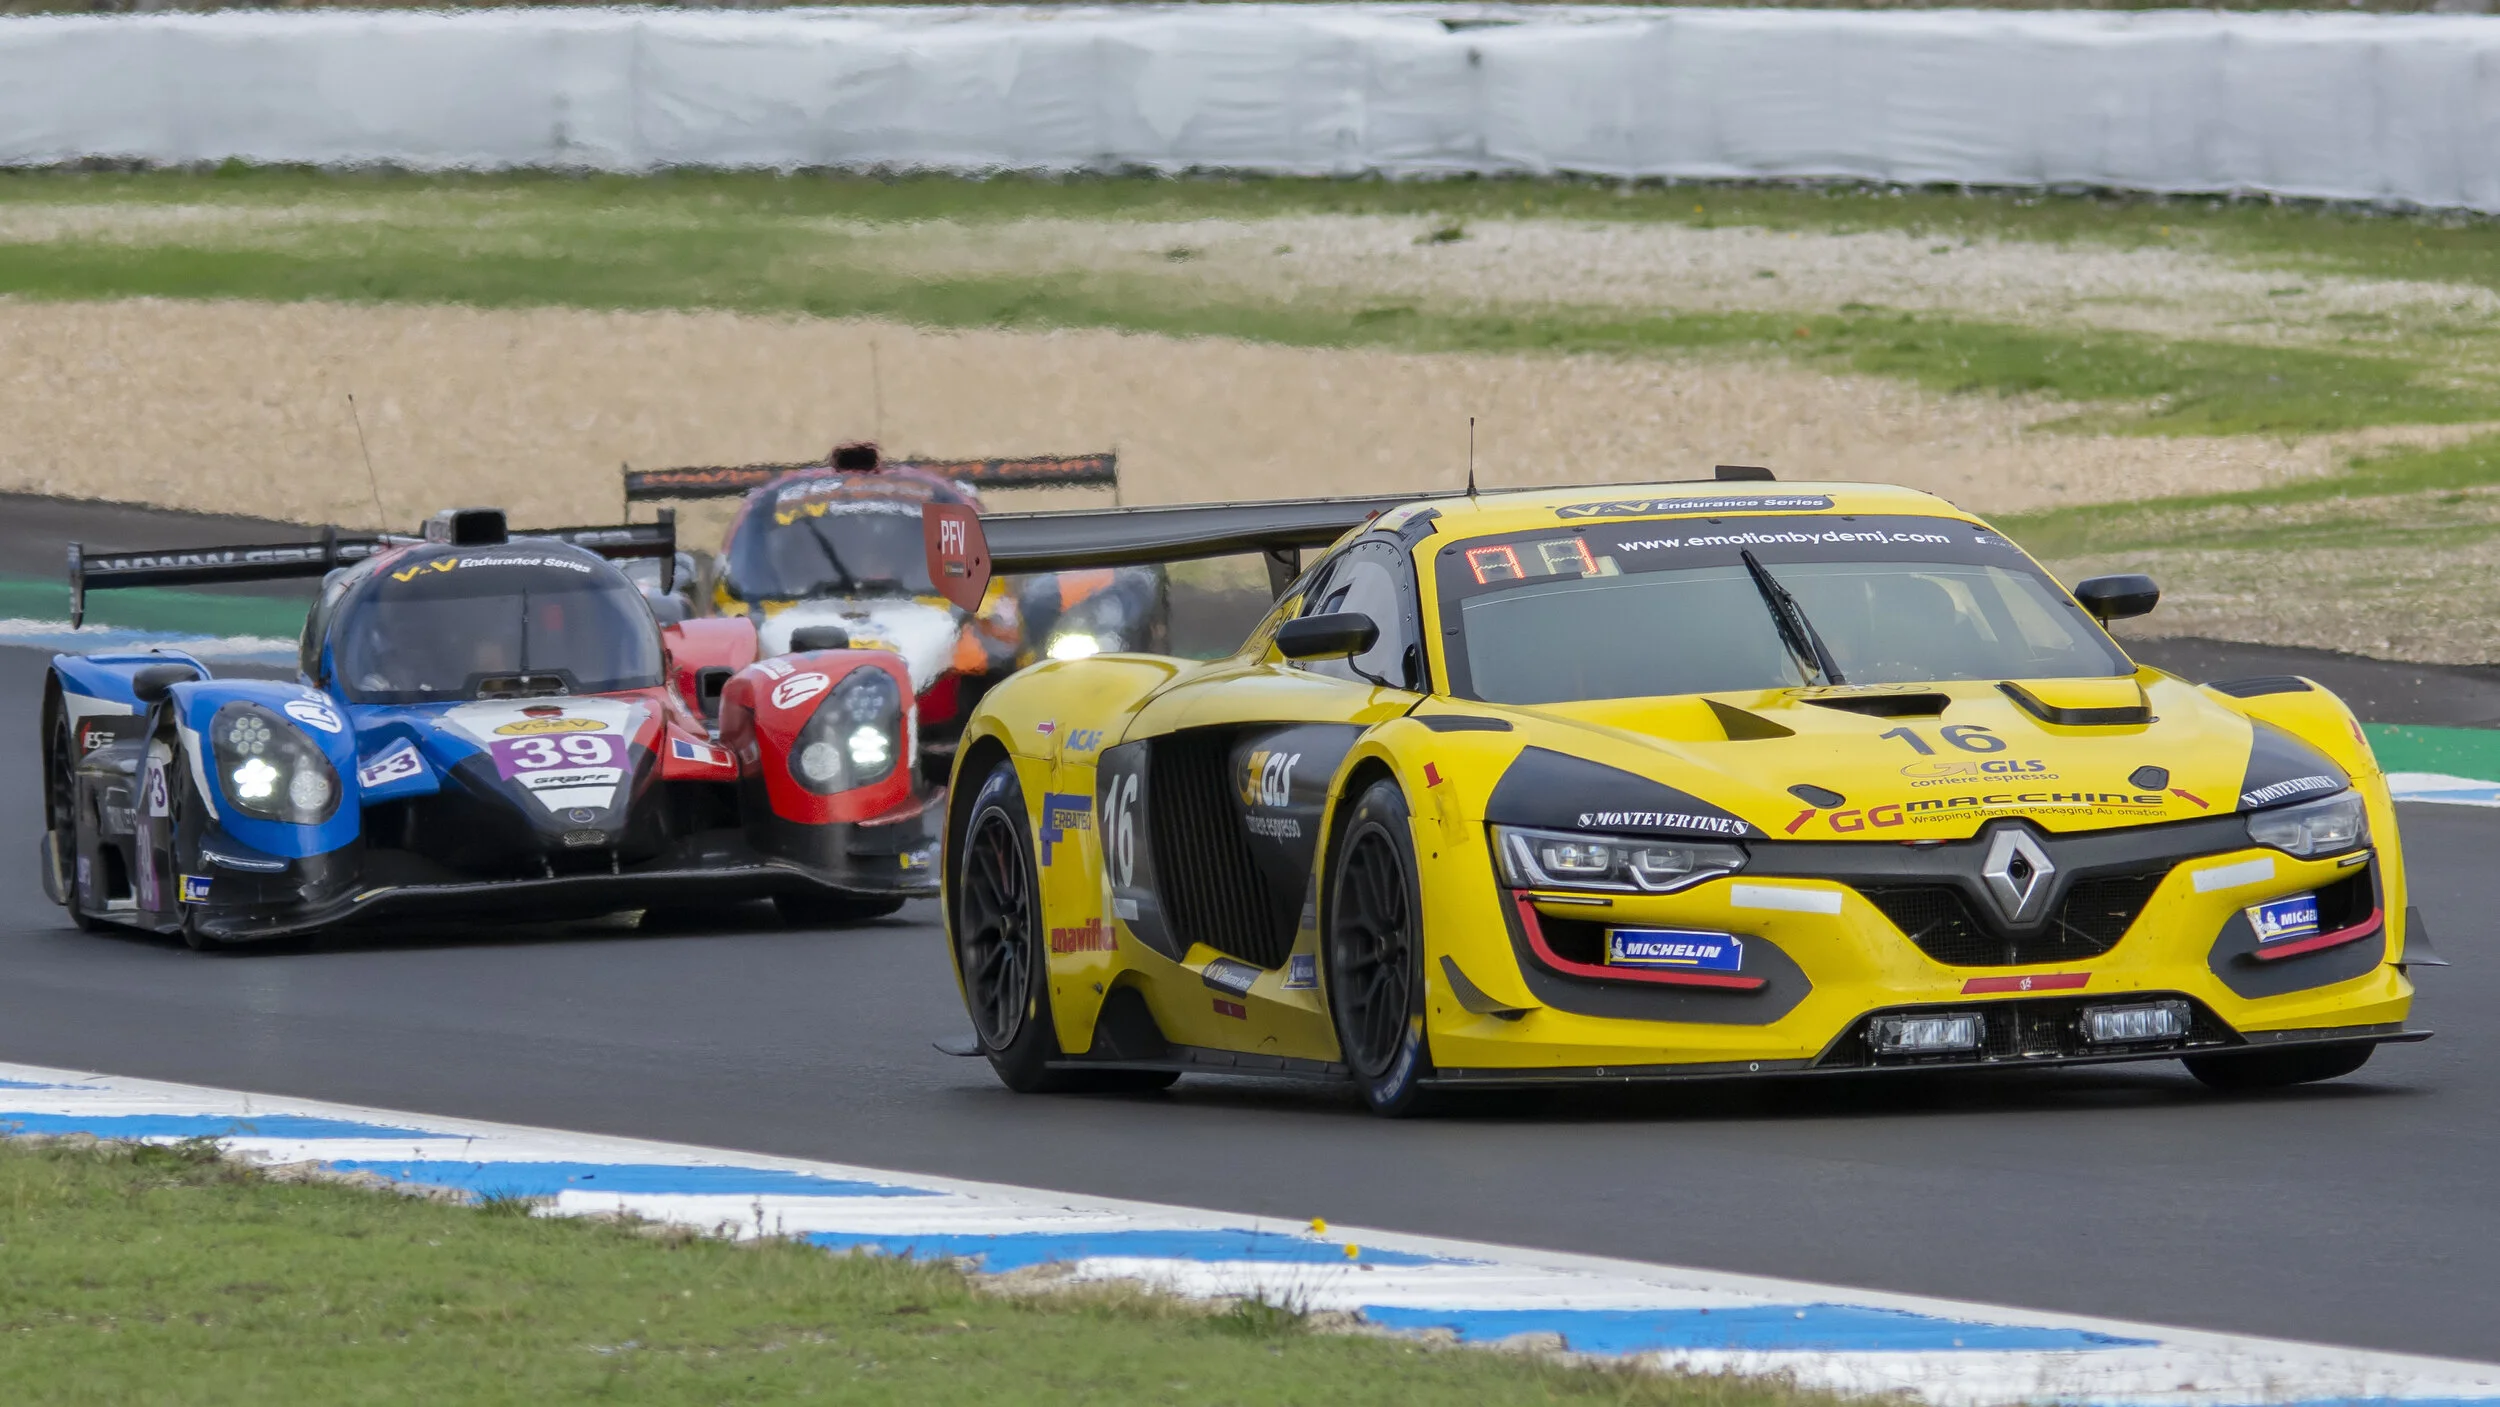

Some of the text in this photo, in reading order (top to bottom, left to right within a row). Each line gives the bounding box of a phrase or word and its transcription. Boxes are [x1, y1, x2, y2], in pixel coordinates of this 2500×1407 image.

[1657, 499, 1759, 510] Endurance
[1764, 499, 1824, 507] Series
[940, 520, 965, 555] PFV
[1617, 530, 1951, 552] www.emotionbydemj.com
[458, 557, 541, 569] Endurance
[542, 558, 591, 573] Series
[1880, 725, 2007, 755] 16
[510, 735, 612, 769] 39
[364, 753, 416, 781] P3
[1980, 760, 2046, 773] GLS
[534, 774, 610, 784] GRAFF
[1261, 752, 1301, 807] GLS
[1910, 773, 2060, 788] corriere espresso
[2253, 776, 2332, 803] MONTEVERTINE
[1592, 812, 1733, 833] MONTEVERTINE
[1828, 793, 2164, 833] GG MACCHINE
[1910, 811, 1971, 824] Wrapping
[1974, 808, 2025, 817] Machne
[2028, 806, 2093, 816] Packaging
[1104, 773, 1138, 888] 16
[1626, 943, 1721, 958] MICHELIN
